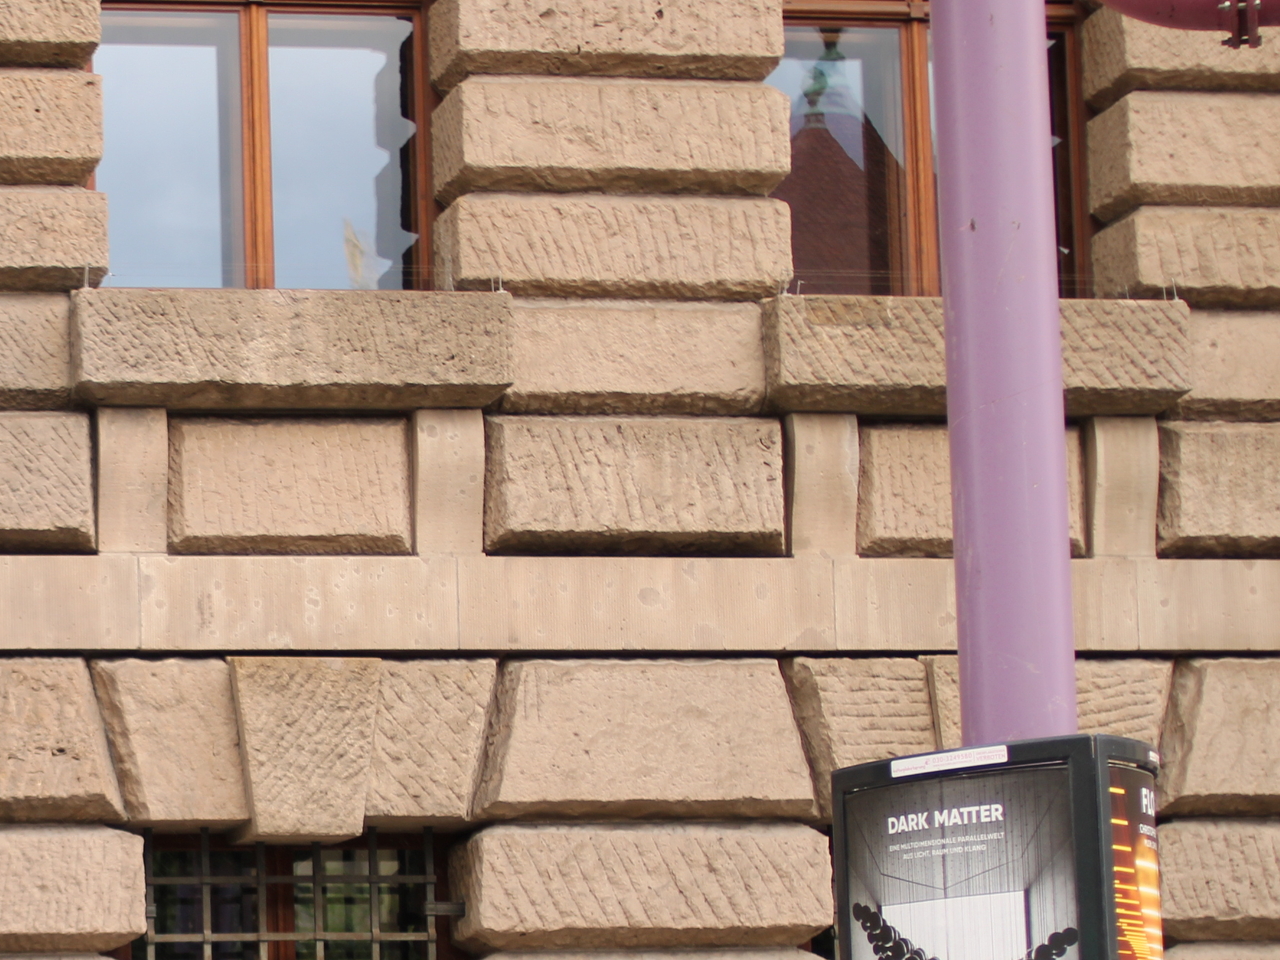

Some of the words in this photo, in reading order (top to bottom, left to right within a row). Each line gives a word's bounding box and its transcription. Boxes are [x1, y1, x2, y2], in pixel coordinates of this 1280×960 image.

[887, 811, 929, 835] DARK
[934, 803, 1004, 828] MATTER
[957, 831, 1005, 842] PARALLELWELT
[932, 848, 949, 856] RAUM
[949, 846, 963, 854] UND
[964, 844, 987, 852] KLANG
